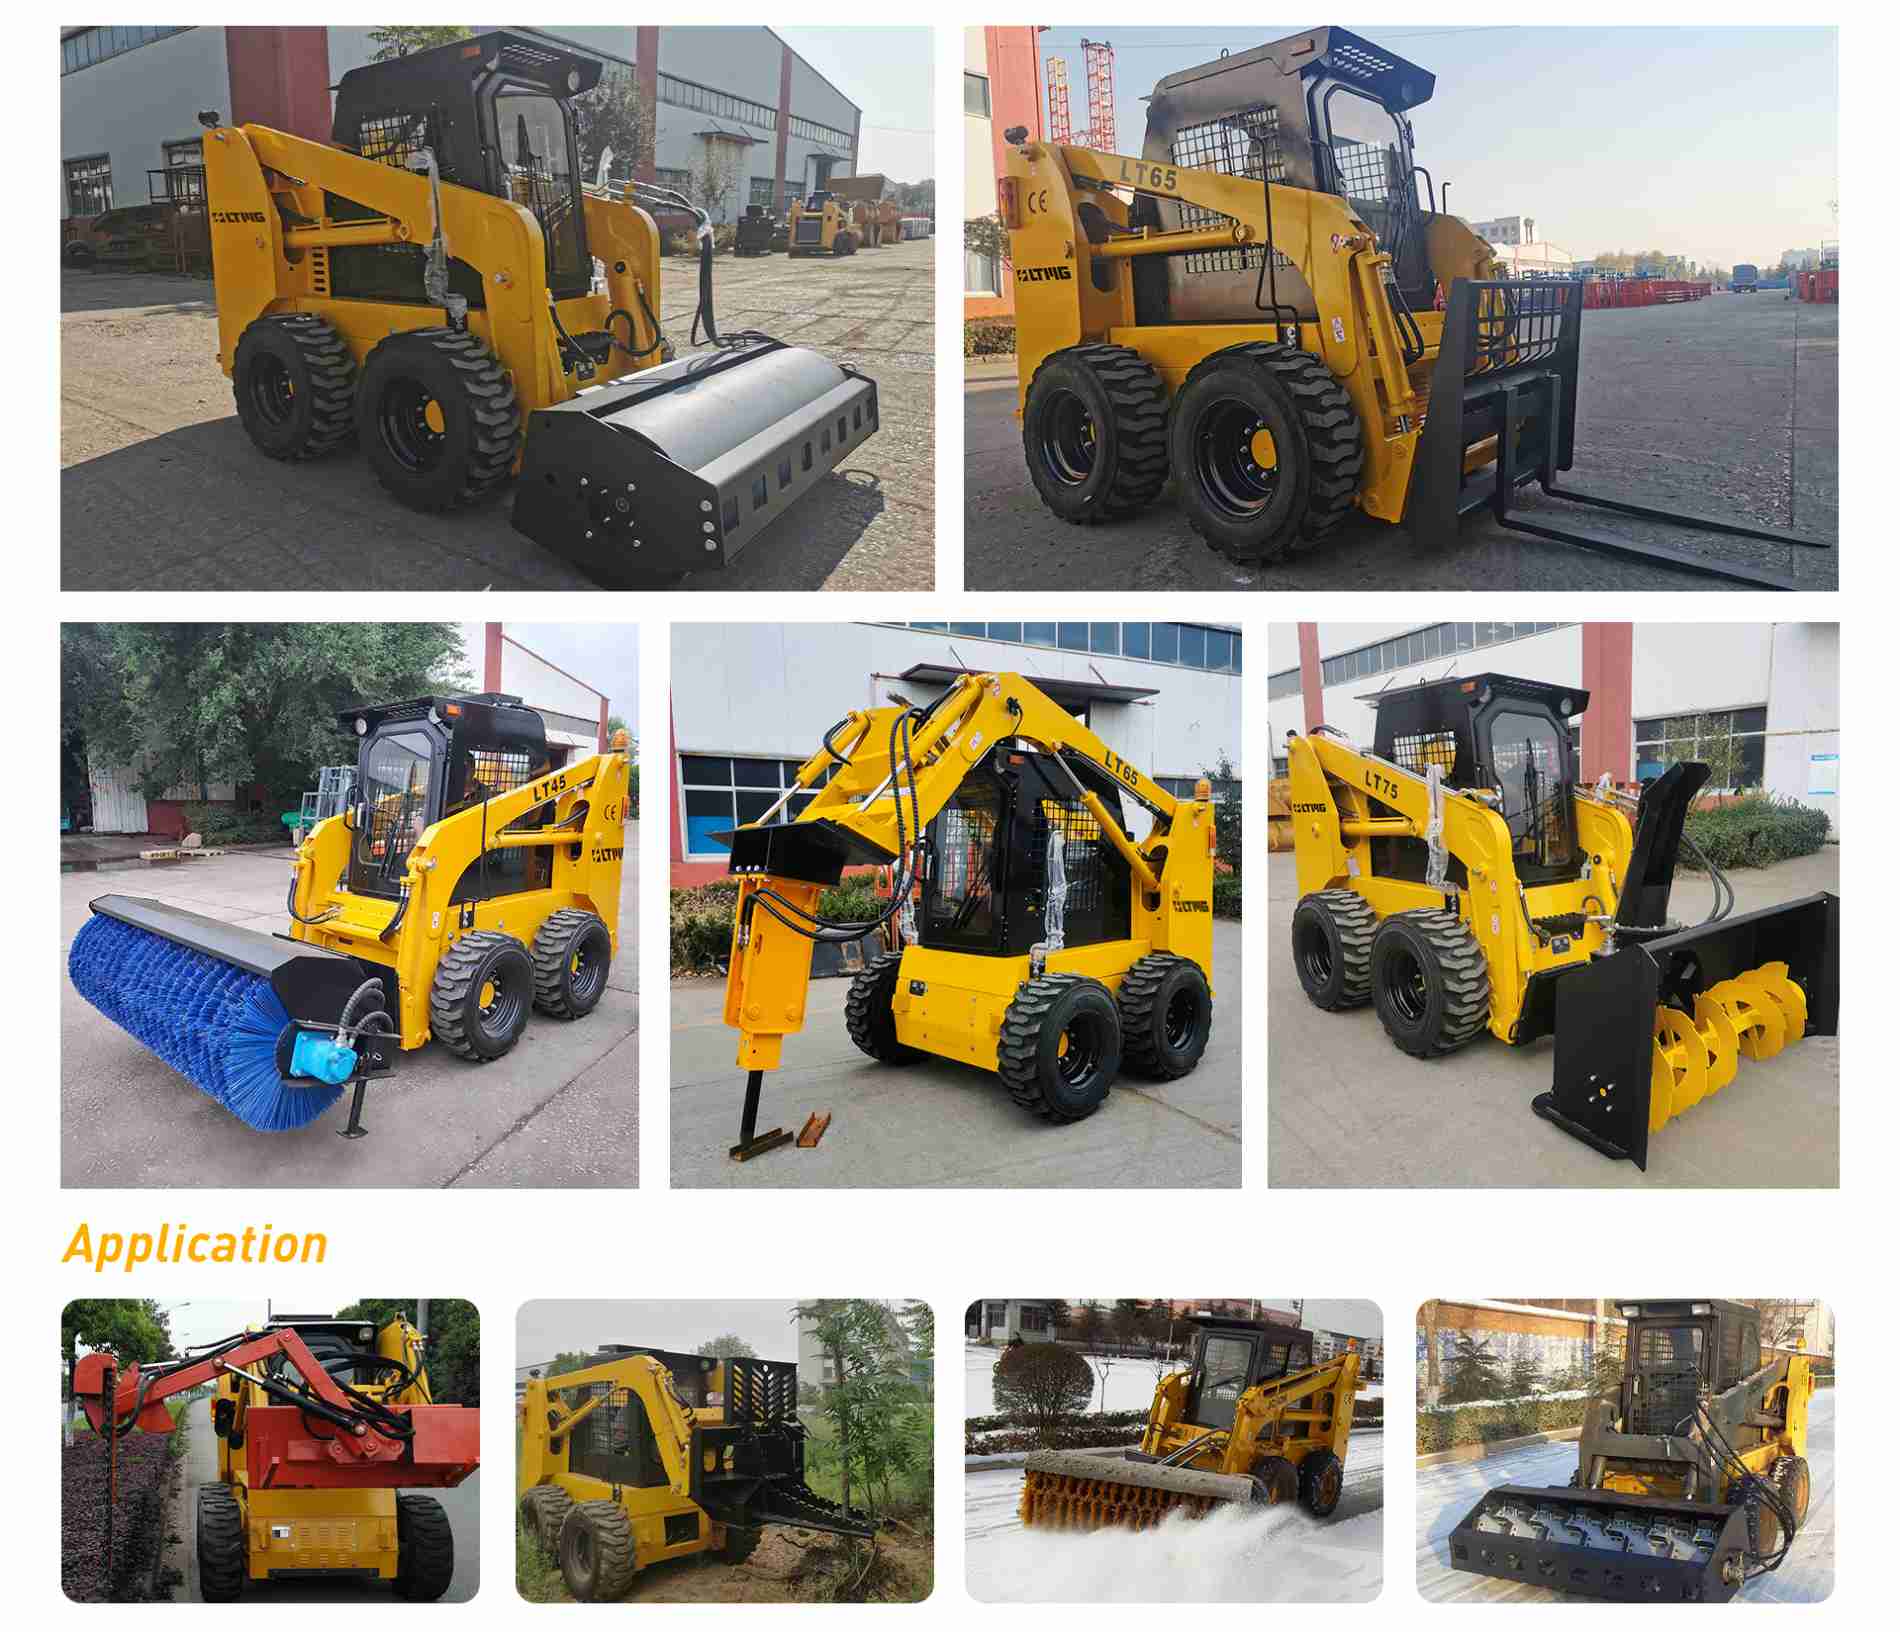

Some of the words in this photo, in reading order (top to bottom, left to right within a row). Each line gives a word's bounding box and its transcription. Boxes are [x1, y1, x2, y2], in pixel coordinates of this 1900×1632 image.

[1119, 160, 1178, 191] LT65
[1028, 190, 1048, 214] CE
[1028, 266, 1072, 282] LTMG
[1104, 750, 1138, 786] LT65
[533, 775, 566, 801] LT45
[1365, 769, 1399, 799] LT75
